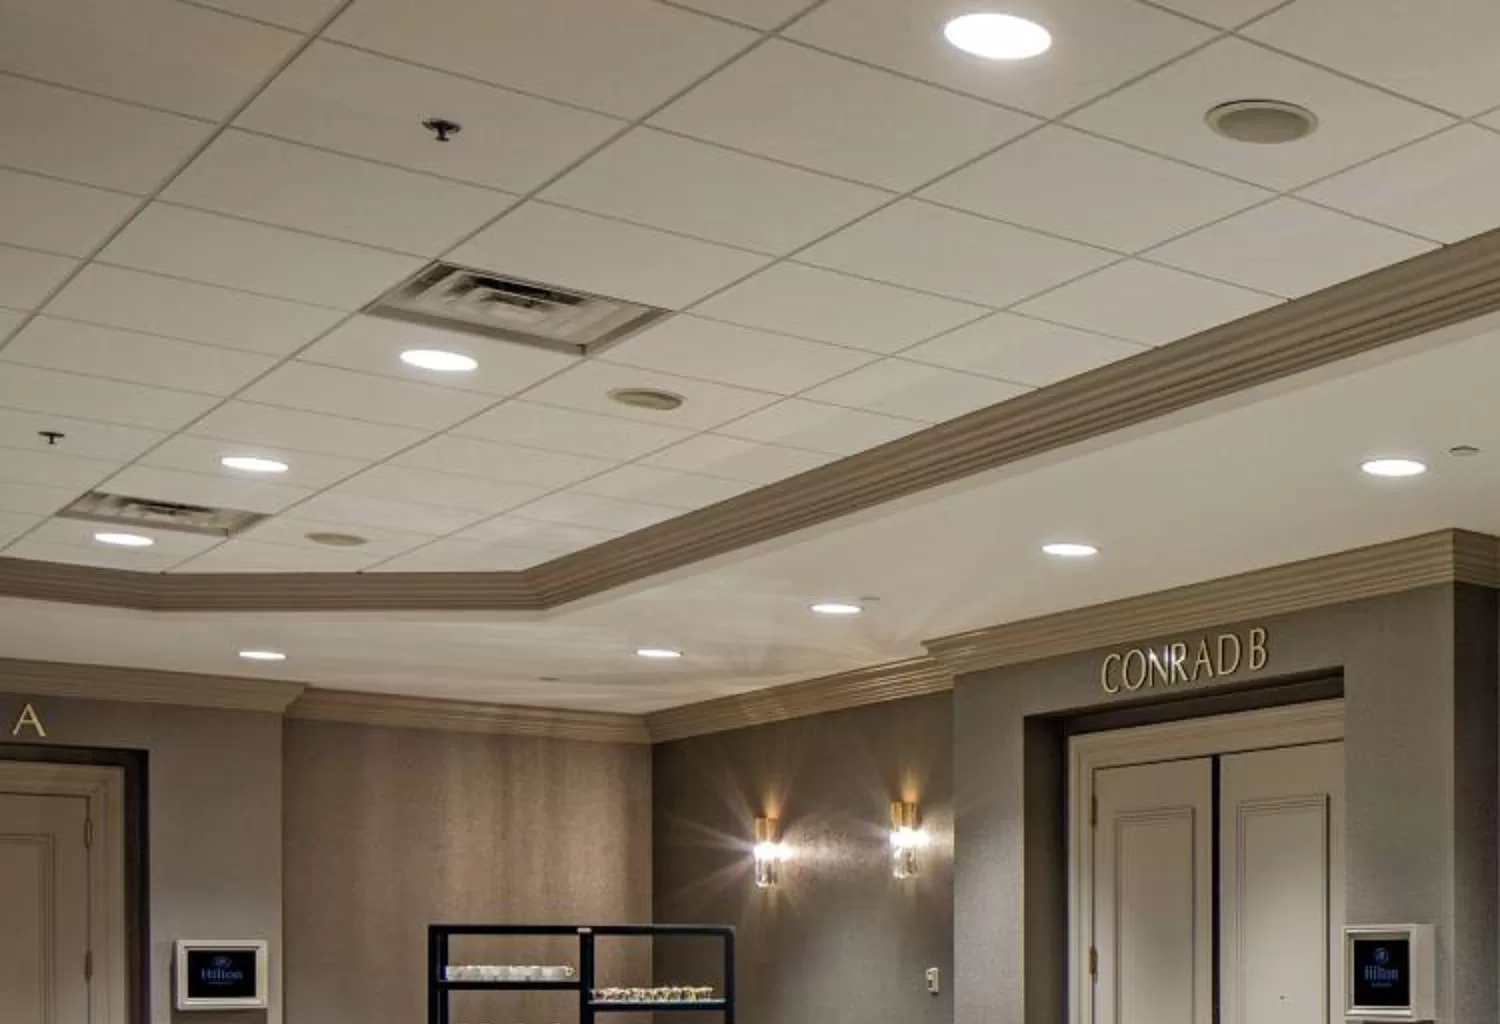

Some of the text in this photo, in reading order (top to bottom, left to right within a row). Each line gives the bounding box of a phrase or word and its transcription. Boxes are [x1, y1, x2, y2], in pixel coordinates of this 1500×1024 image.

[1101, 627, 1268, 694] CONRAD B
[12, 703, 46, 737] A
